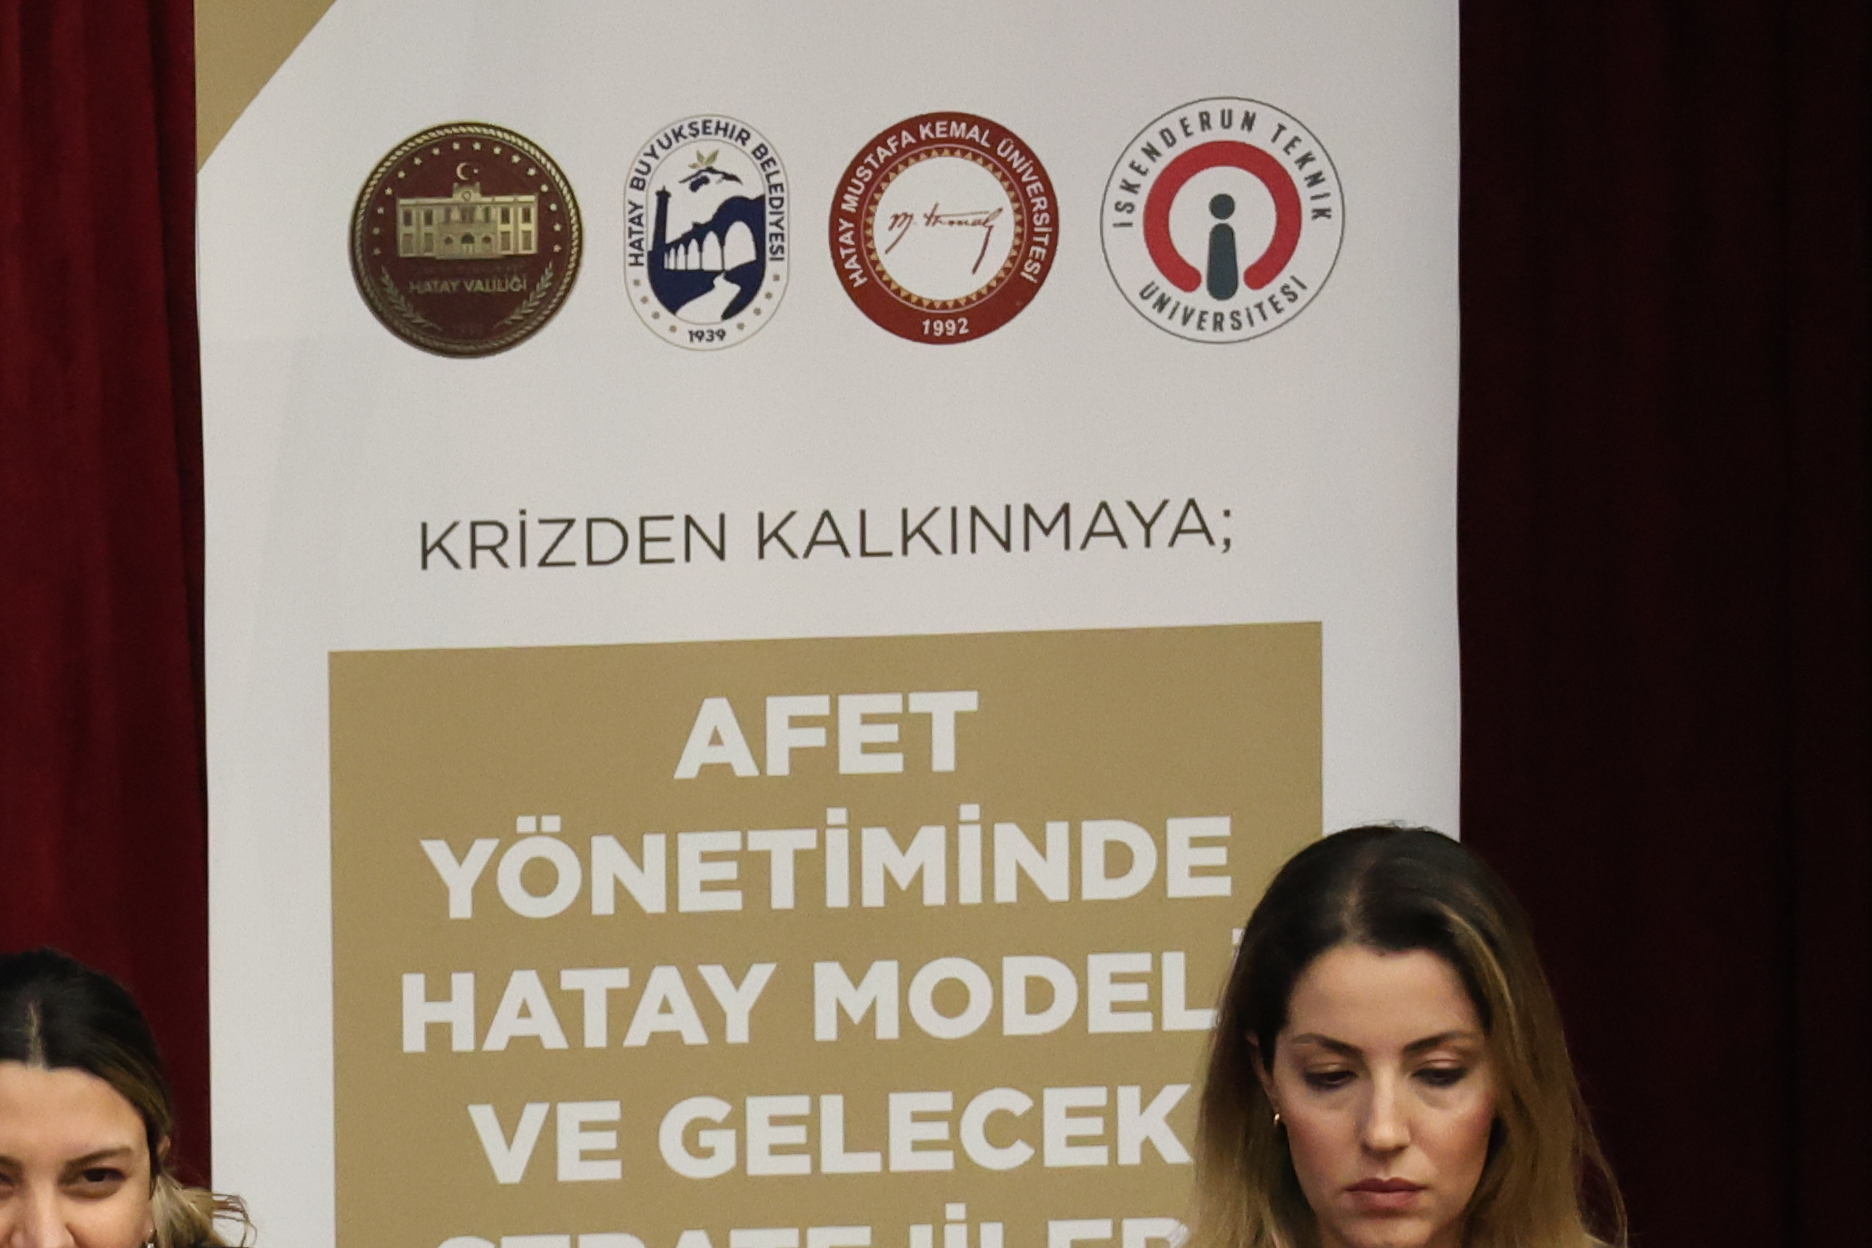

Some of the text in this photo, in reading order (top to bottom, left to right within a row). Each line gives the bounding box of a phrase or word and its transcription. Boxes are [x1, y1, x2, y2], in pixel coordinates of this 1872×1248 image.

[629, 200, 644, 267] HATAY
[838, 120, 1052, 288] HATAY MUSTAFA KEMAL ÜNİVERSİTESİ
[688, 329, 728, 344] 1939
[922, 317, 970, 337] 1992
[421, 498, 1233, 572] KRİZDEN KALKINMAYA;
[674, 691, 979, 780] AFET
[420, 804, 1233, 919] YÖNETİMİNDE
[402, 928, 1244, 1053] HATAY MODEL
[468, 1085, 1194, 1184] VE GELECEK
